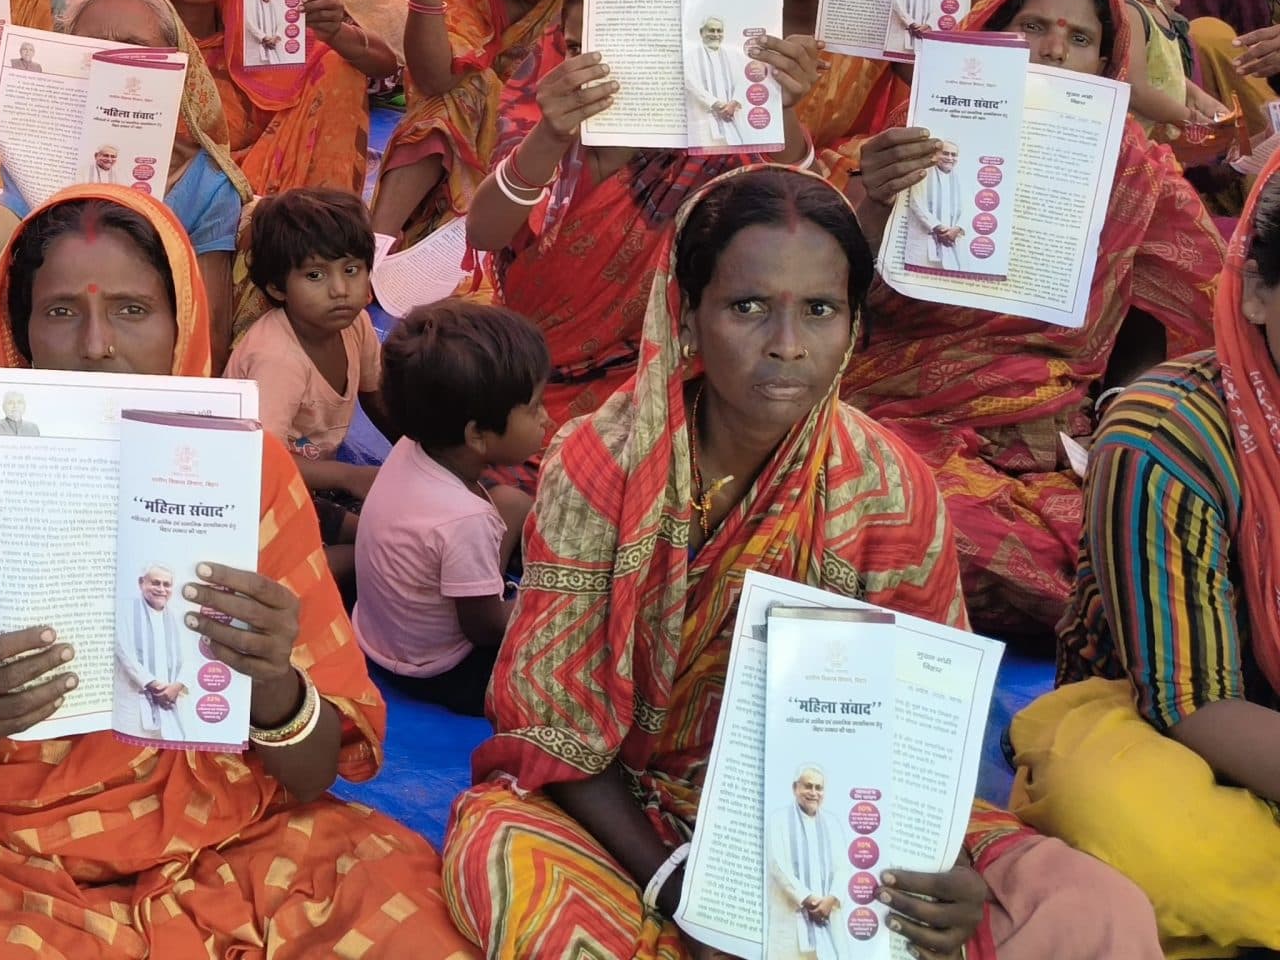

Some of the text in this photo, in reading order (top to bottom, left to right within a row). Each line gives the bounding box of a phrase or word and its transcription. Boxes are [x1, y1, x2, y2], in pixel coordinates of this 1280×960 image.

[931, 94, 1007, 109] “महिला संवाद”
[97, 105, 162, 120] “महिला संवाद”
[134, 496, 235, 517] “महिला संवाद”
[788, 697, 881, 715] “महिला संवाद”
